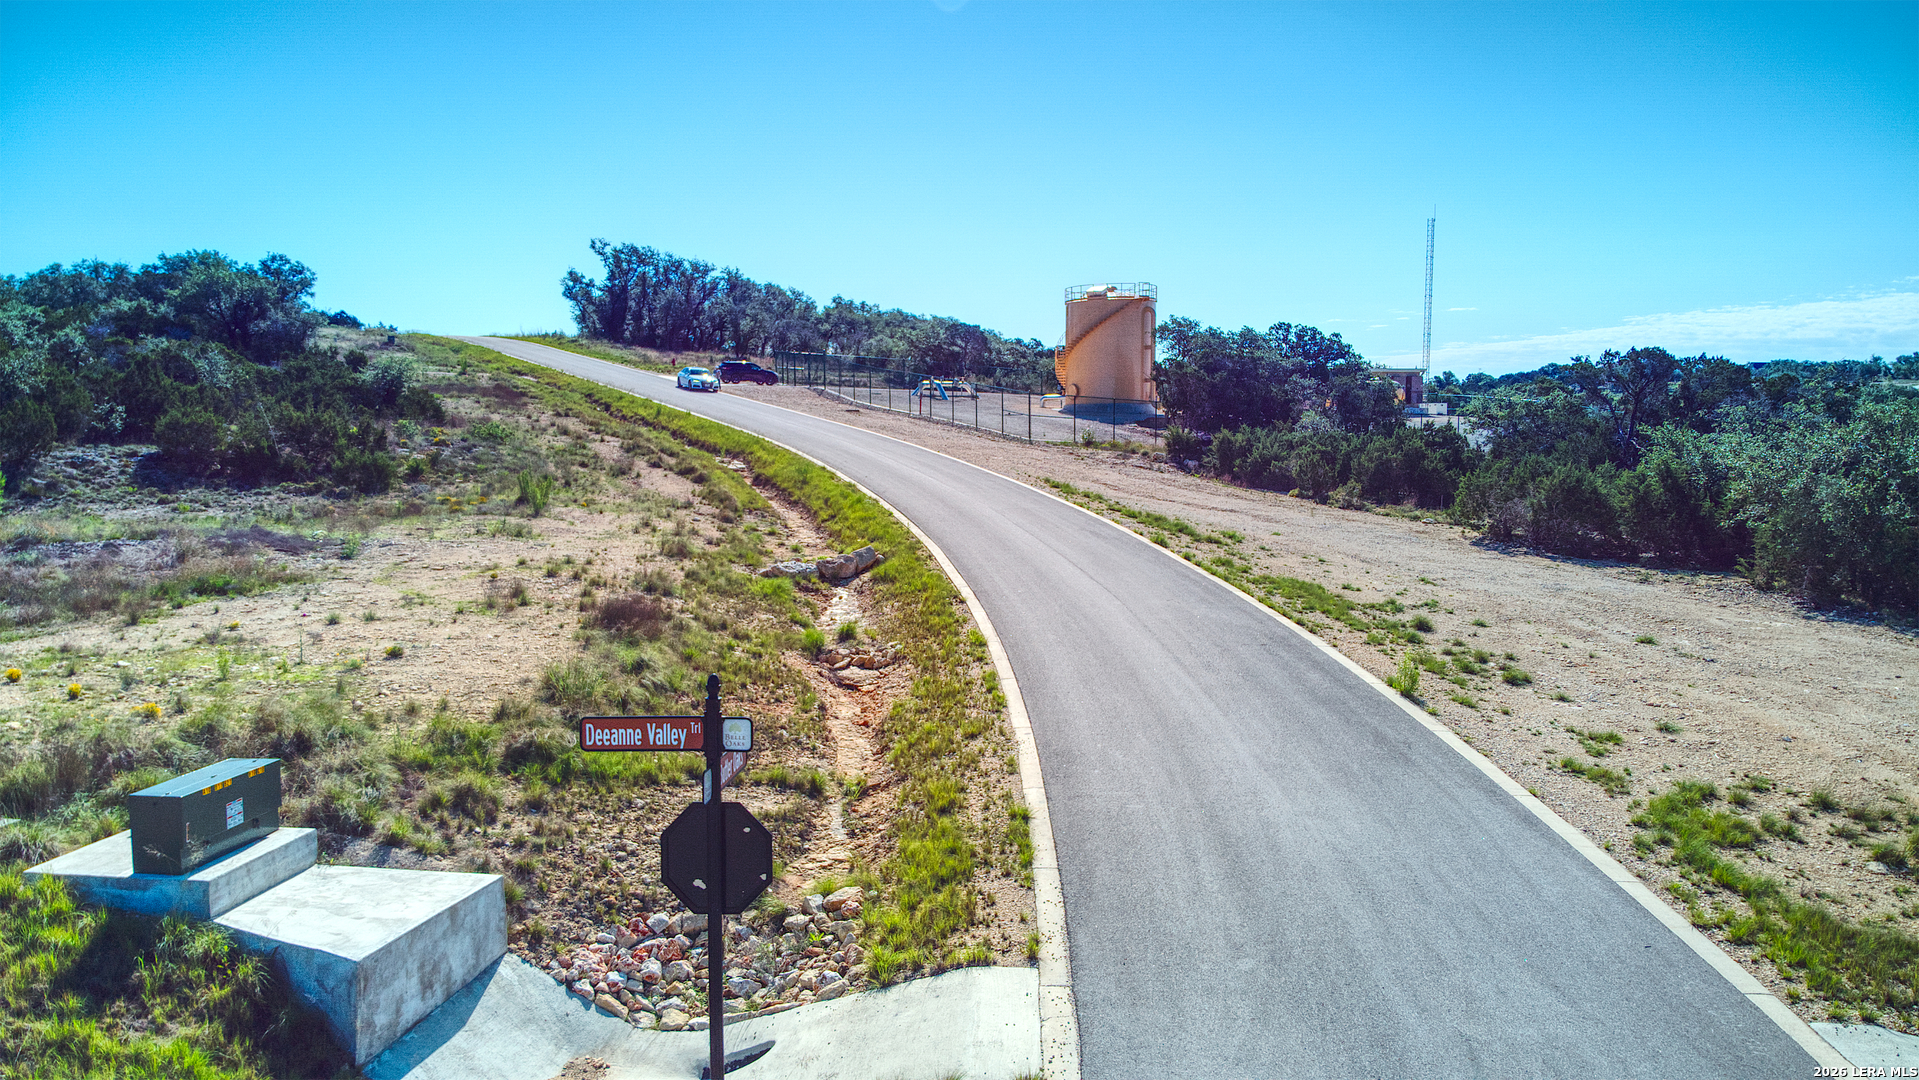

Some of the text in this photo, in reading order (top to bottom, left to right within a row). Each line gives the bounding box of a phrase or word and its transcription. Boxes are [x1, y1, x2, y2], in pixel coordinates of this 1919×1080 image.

[585, 722, 701, 749] Deeanne Valley Trl
